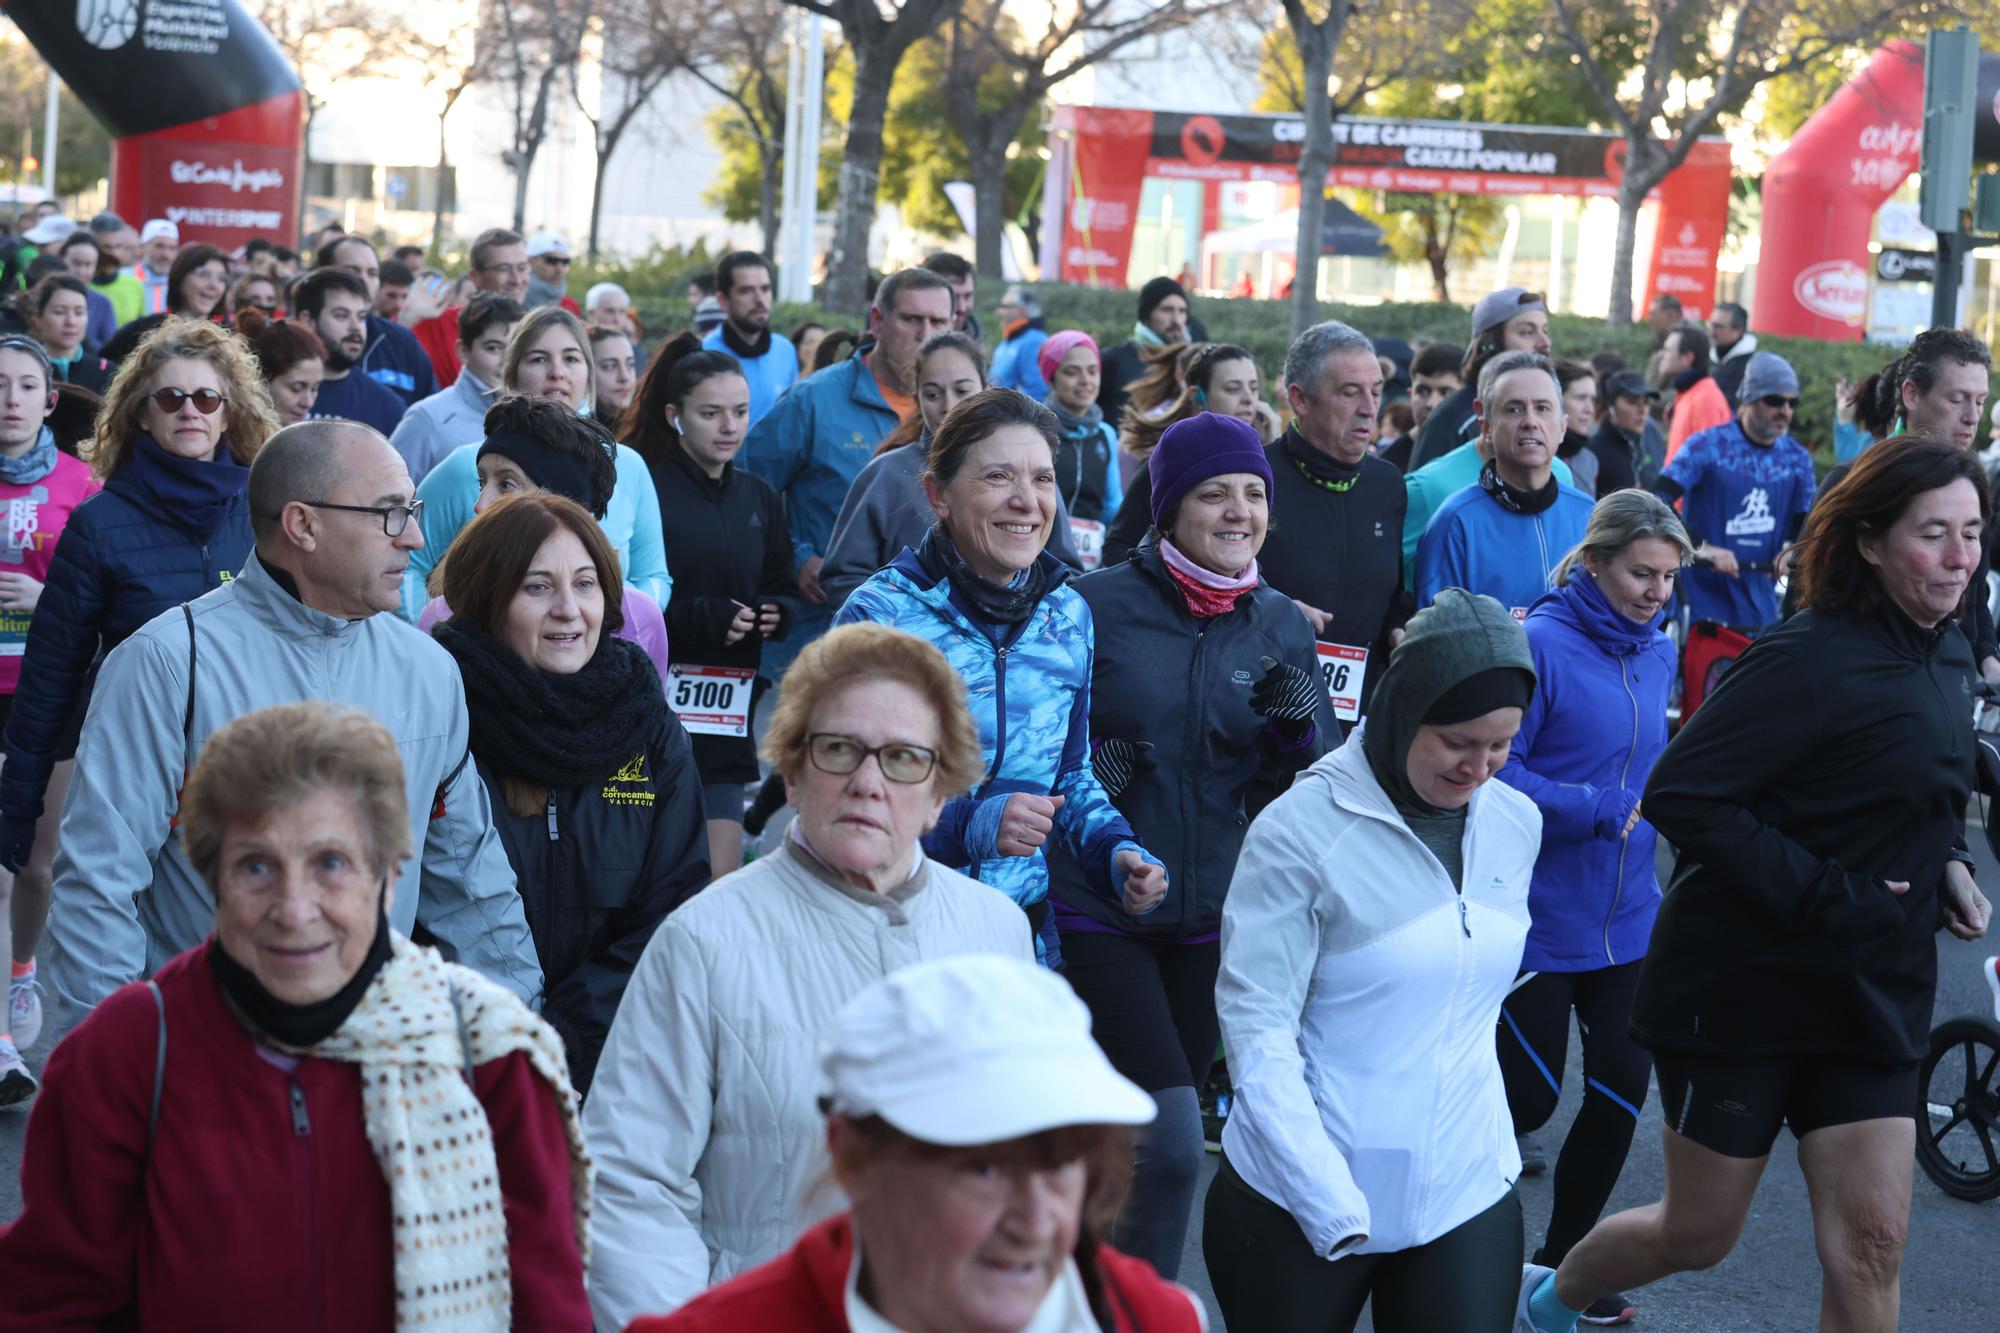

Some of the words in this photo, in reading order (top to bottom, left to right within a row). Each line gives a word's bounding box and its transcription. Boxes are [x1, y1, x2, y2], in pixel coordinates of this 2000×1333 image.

[1352, 124, 1379, 145] DE
[675, 680, 734, 710] 5100
[609, 798, 653, 806] VALENCIA
